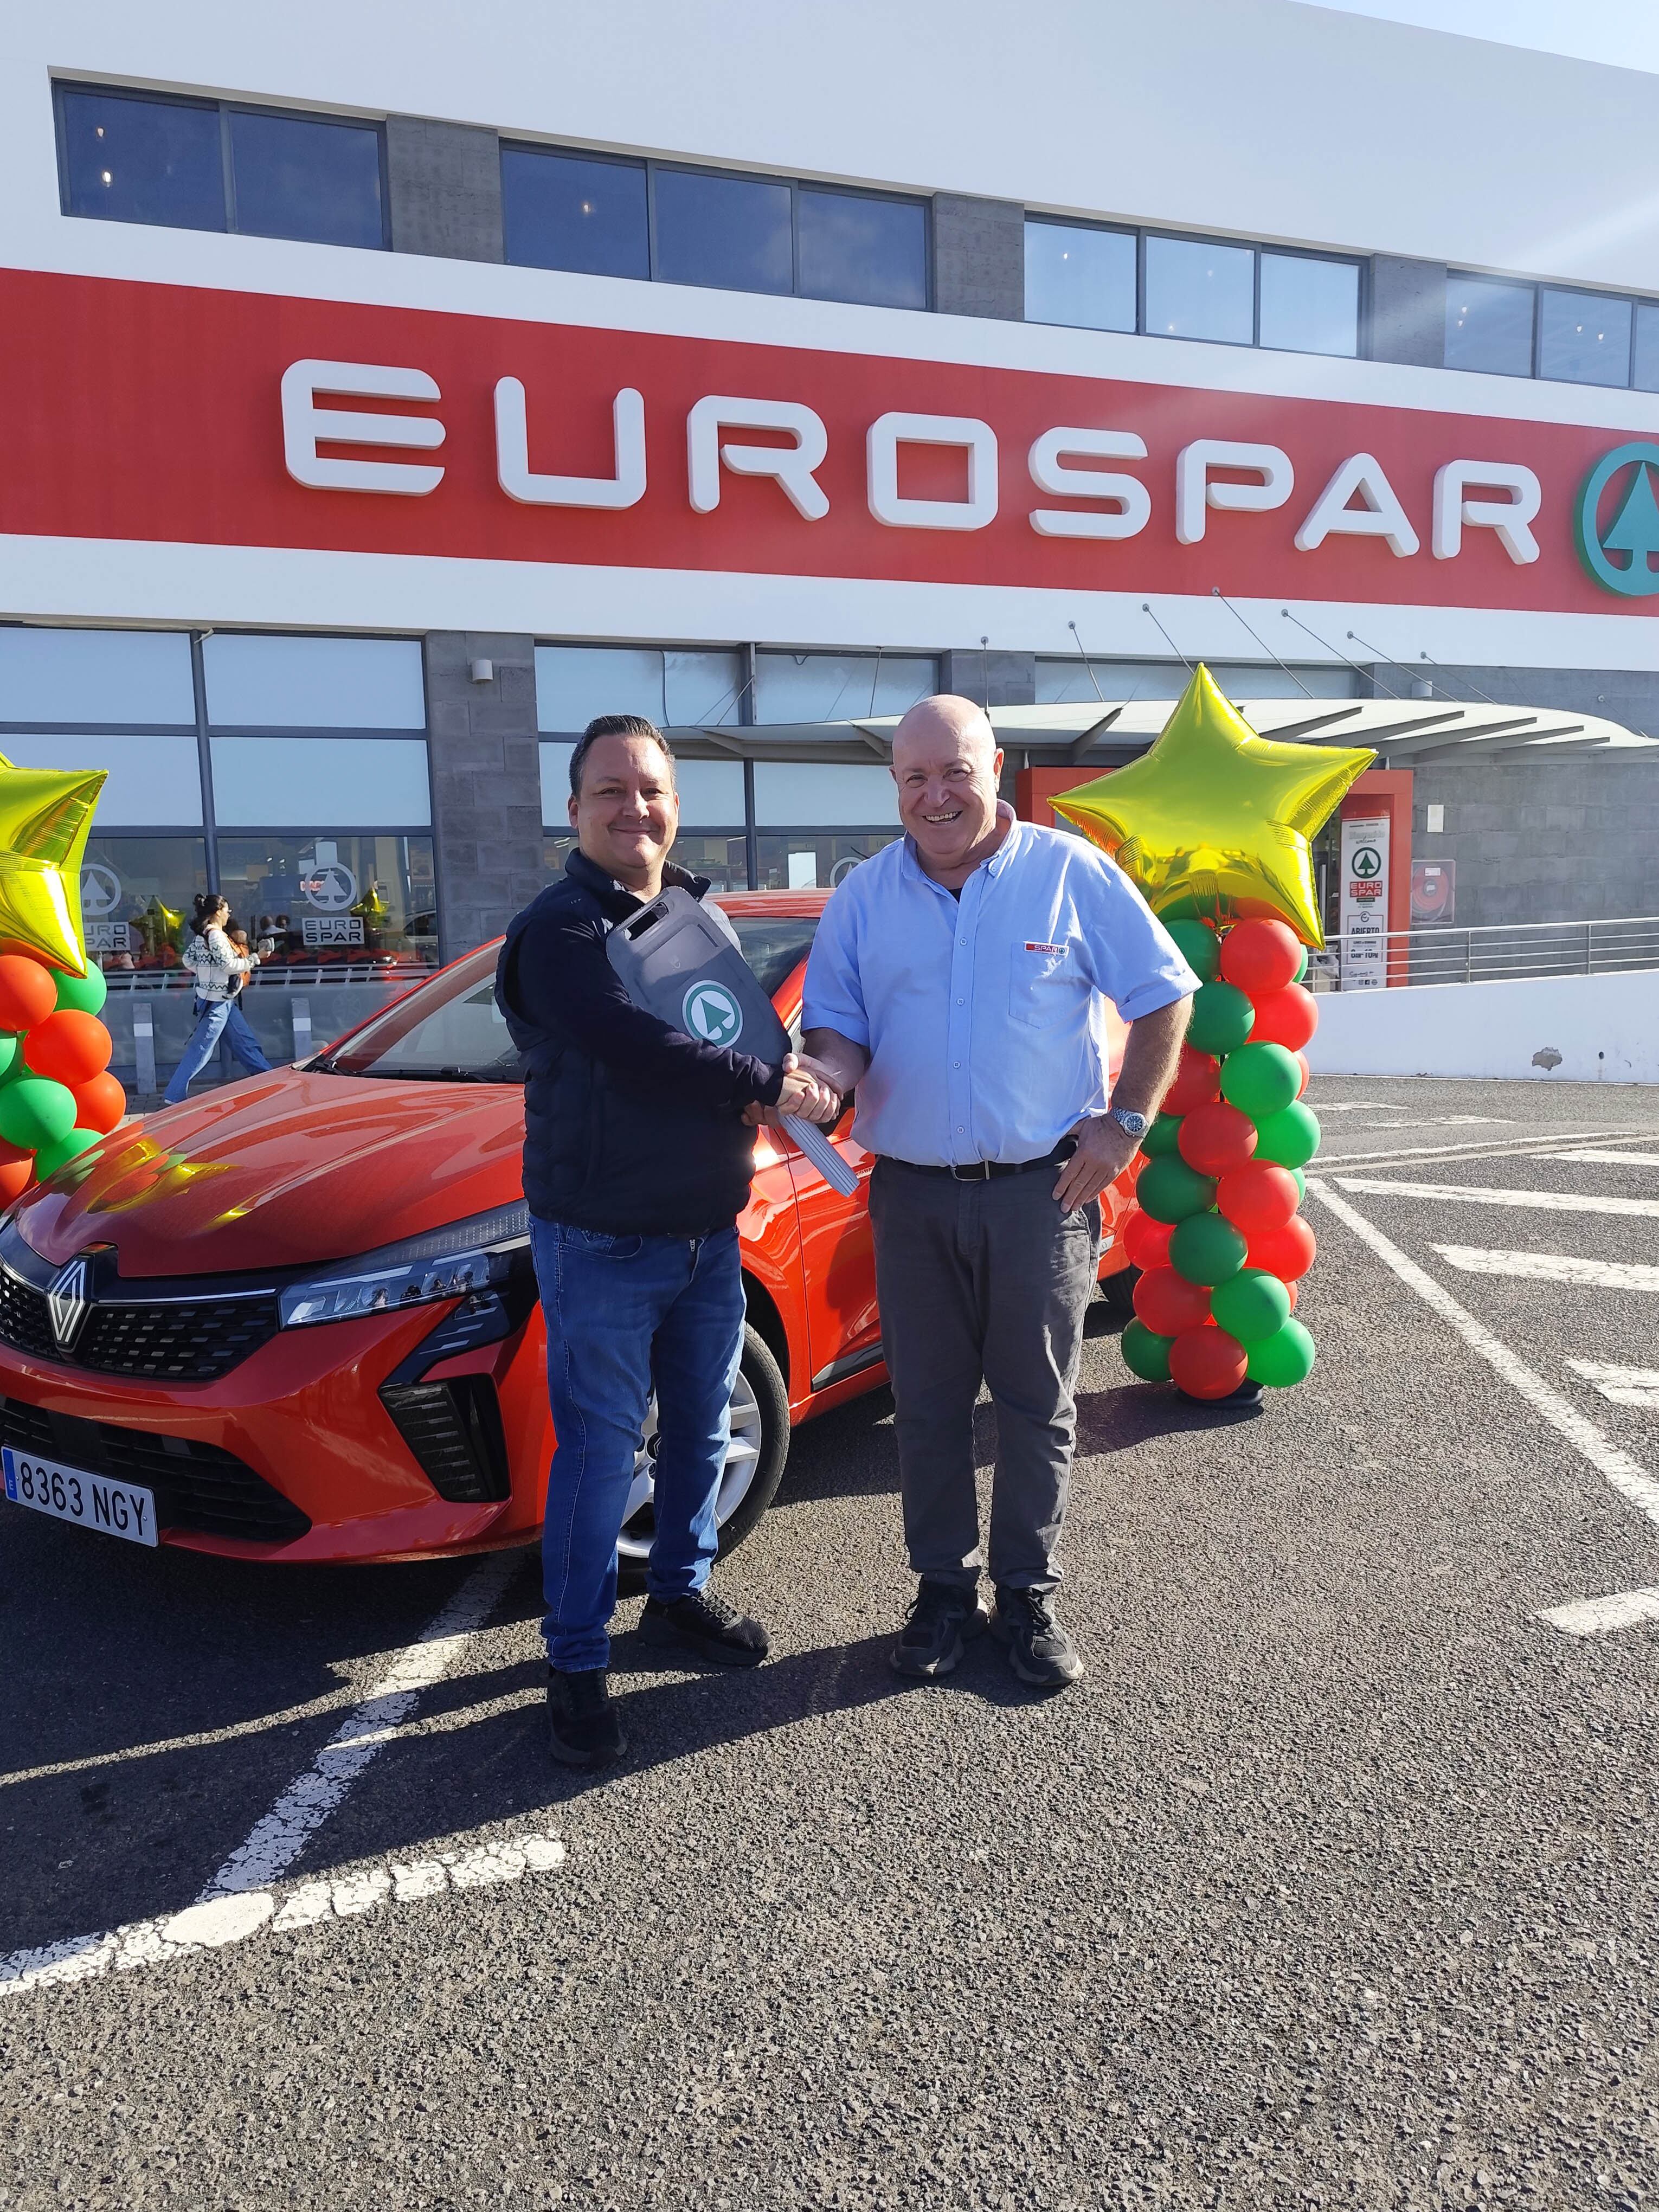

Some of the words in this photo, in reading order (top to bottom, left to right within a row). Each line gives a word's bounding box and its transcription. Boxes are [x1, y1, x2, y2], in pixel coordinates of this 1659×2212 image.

[280, 358, 1542, 565] EUROSPAR
[85, 925, 126, 935] URO
[305, 919, 361, 930] EURO
[306, 931, 361, 942] SPAR
[85, 937, 126, 948] PAR
[9, 1480, 14, 1490] E
[21, 1462, 83, 1517] 8363
[92, 1483, 145, 1536] NGY
